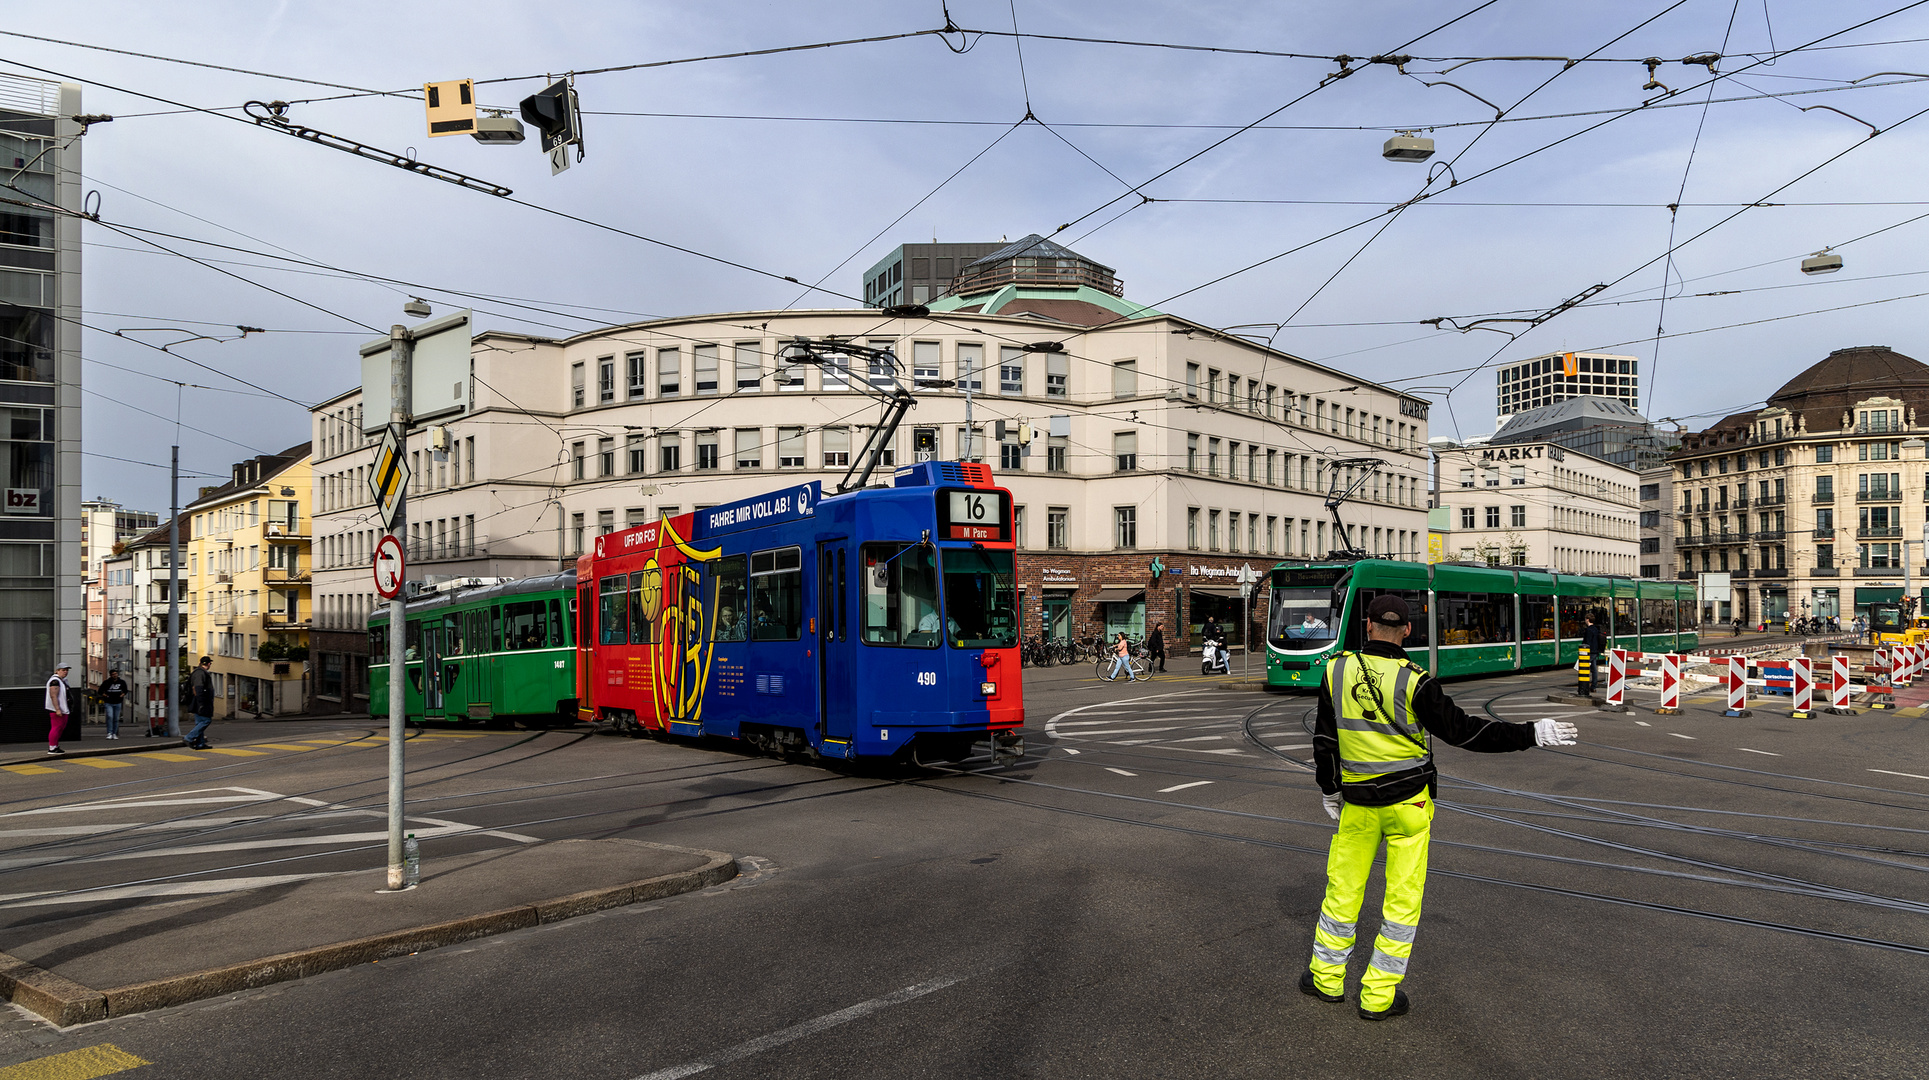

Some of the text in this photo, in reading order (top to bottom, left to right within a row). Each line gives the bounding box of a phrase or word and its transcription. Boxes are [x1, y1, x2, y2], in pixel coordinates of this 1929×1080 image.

[553, 134, 562, 146] 69
[1483, 446, 1544, 461] MARKT
[8, 490, 36, 506] bz
[710, 496, 790, 528] FAHRE MIR VOLL AB!
[964, 494, 985, 520] 16
[624, 528, 656, 547] UFF DR FCB
[964, 528, 988, 538] M Parc
[1190, 565, 1198, 576] Ita
[1200, 566, 1224, 578] Wegman
[1285, 572, 1291, 582] 8
[918, 672, 936, 686] 490
